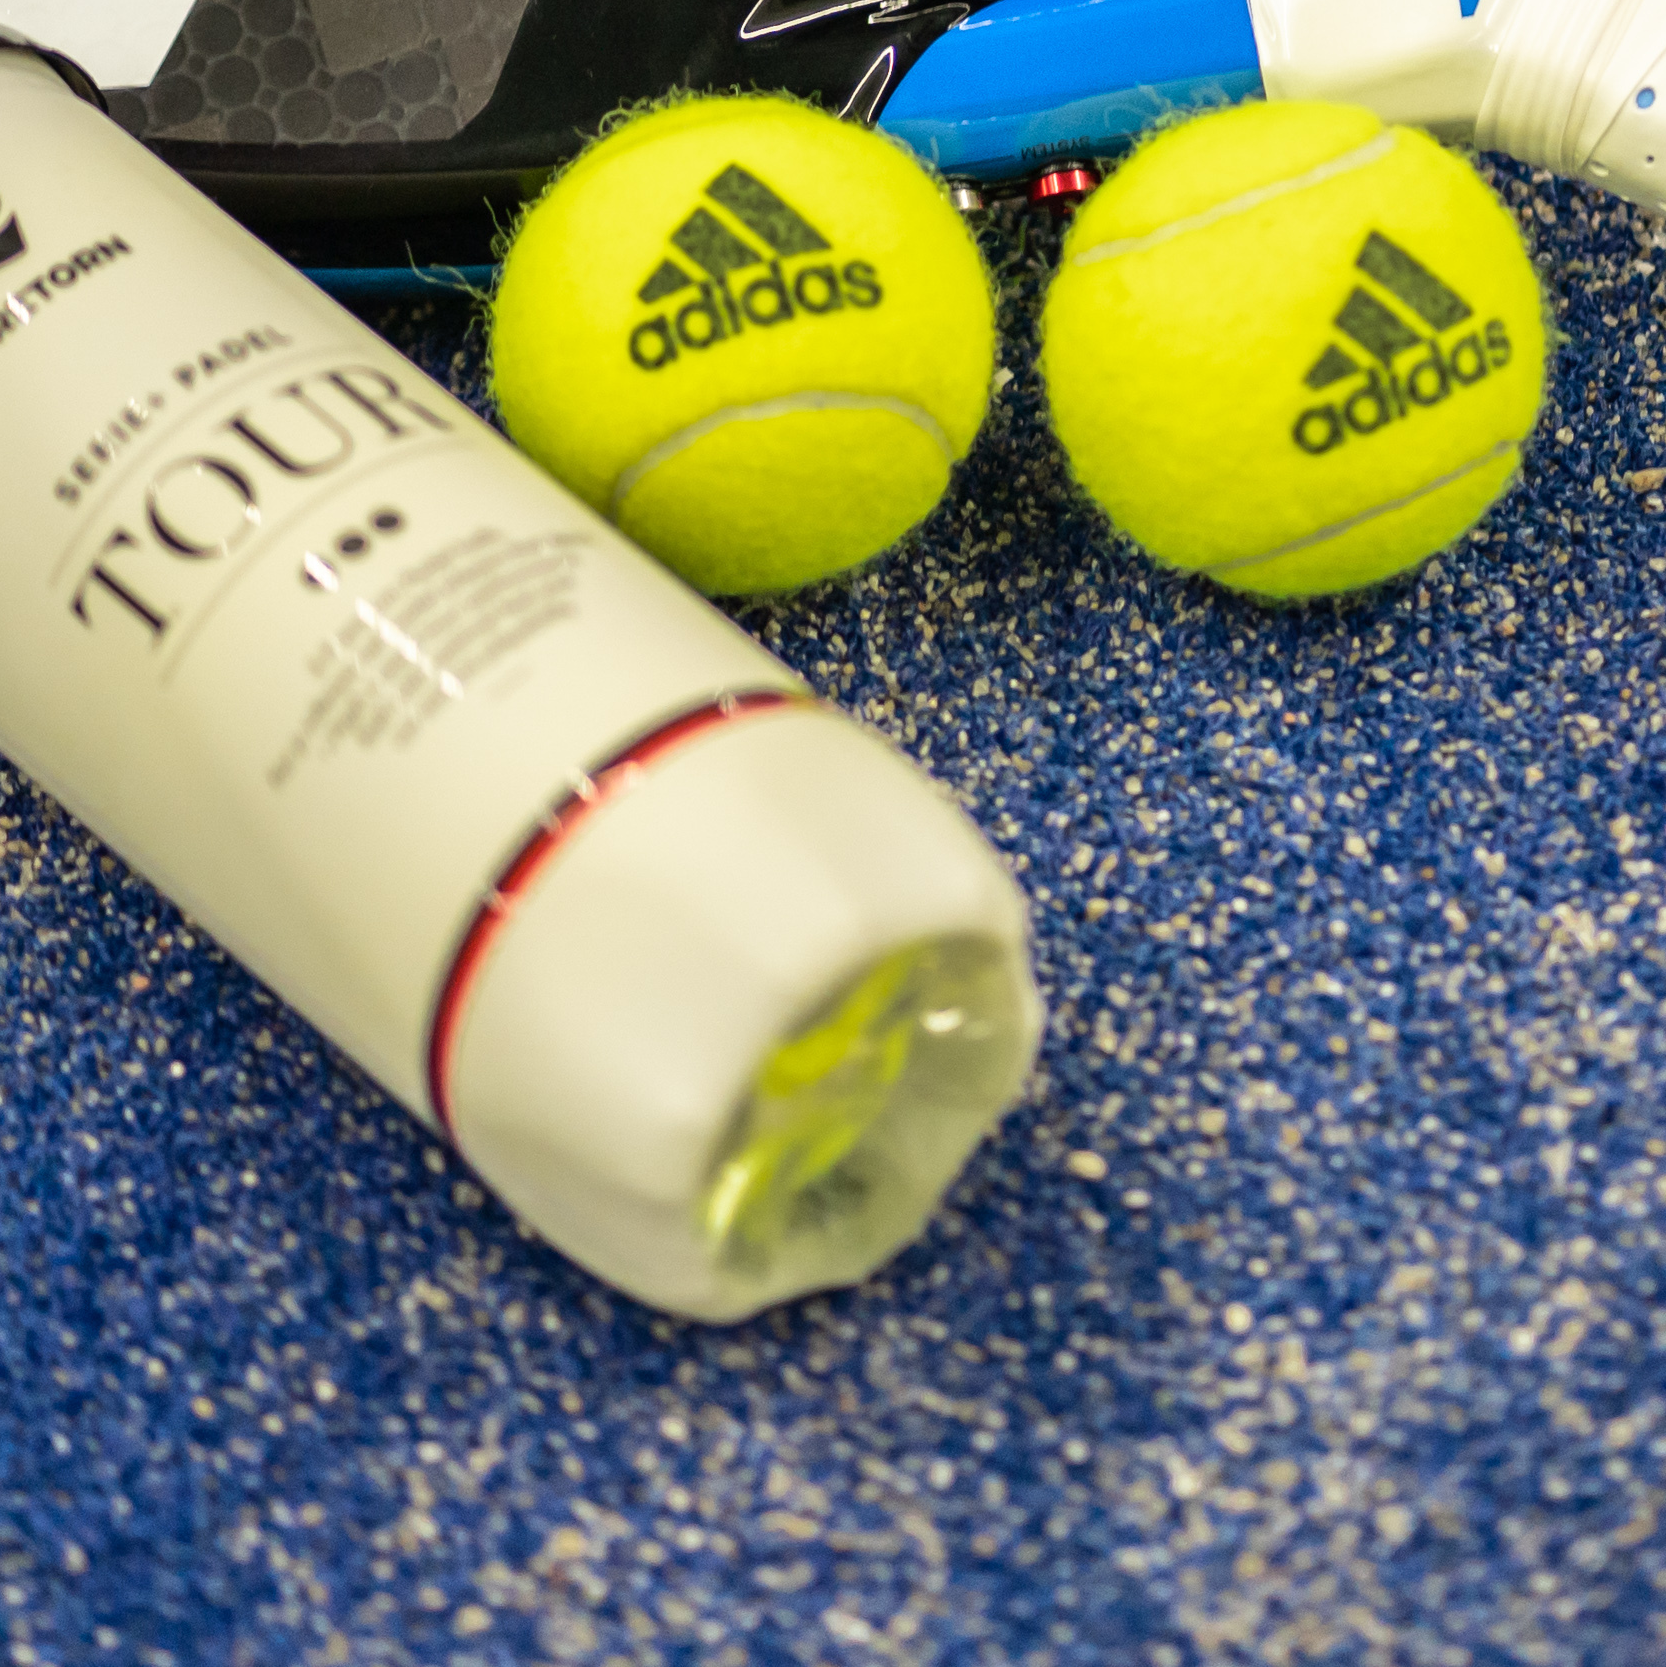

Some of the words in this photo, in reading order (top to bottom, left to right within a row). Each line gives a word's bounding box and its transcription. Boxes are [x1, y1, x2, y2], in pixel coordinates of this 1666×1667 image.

[170, 325, 292, 390] PADEL
[627, 254, 885, 372] adidas
[1290, 315, 1513, 456] adidas
[69, 363, 455, 647] TOUR
